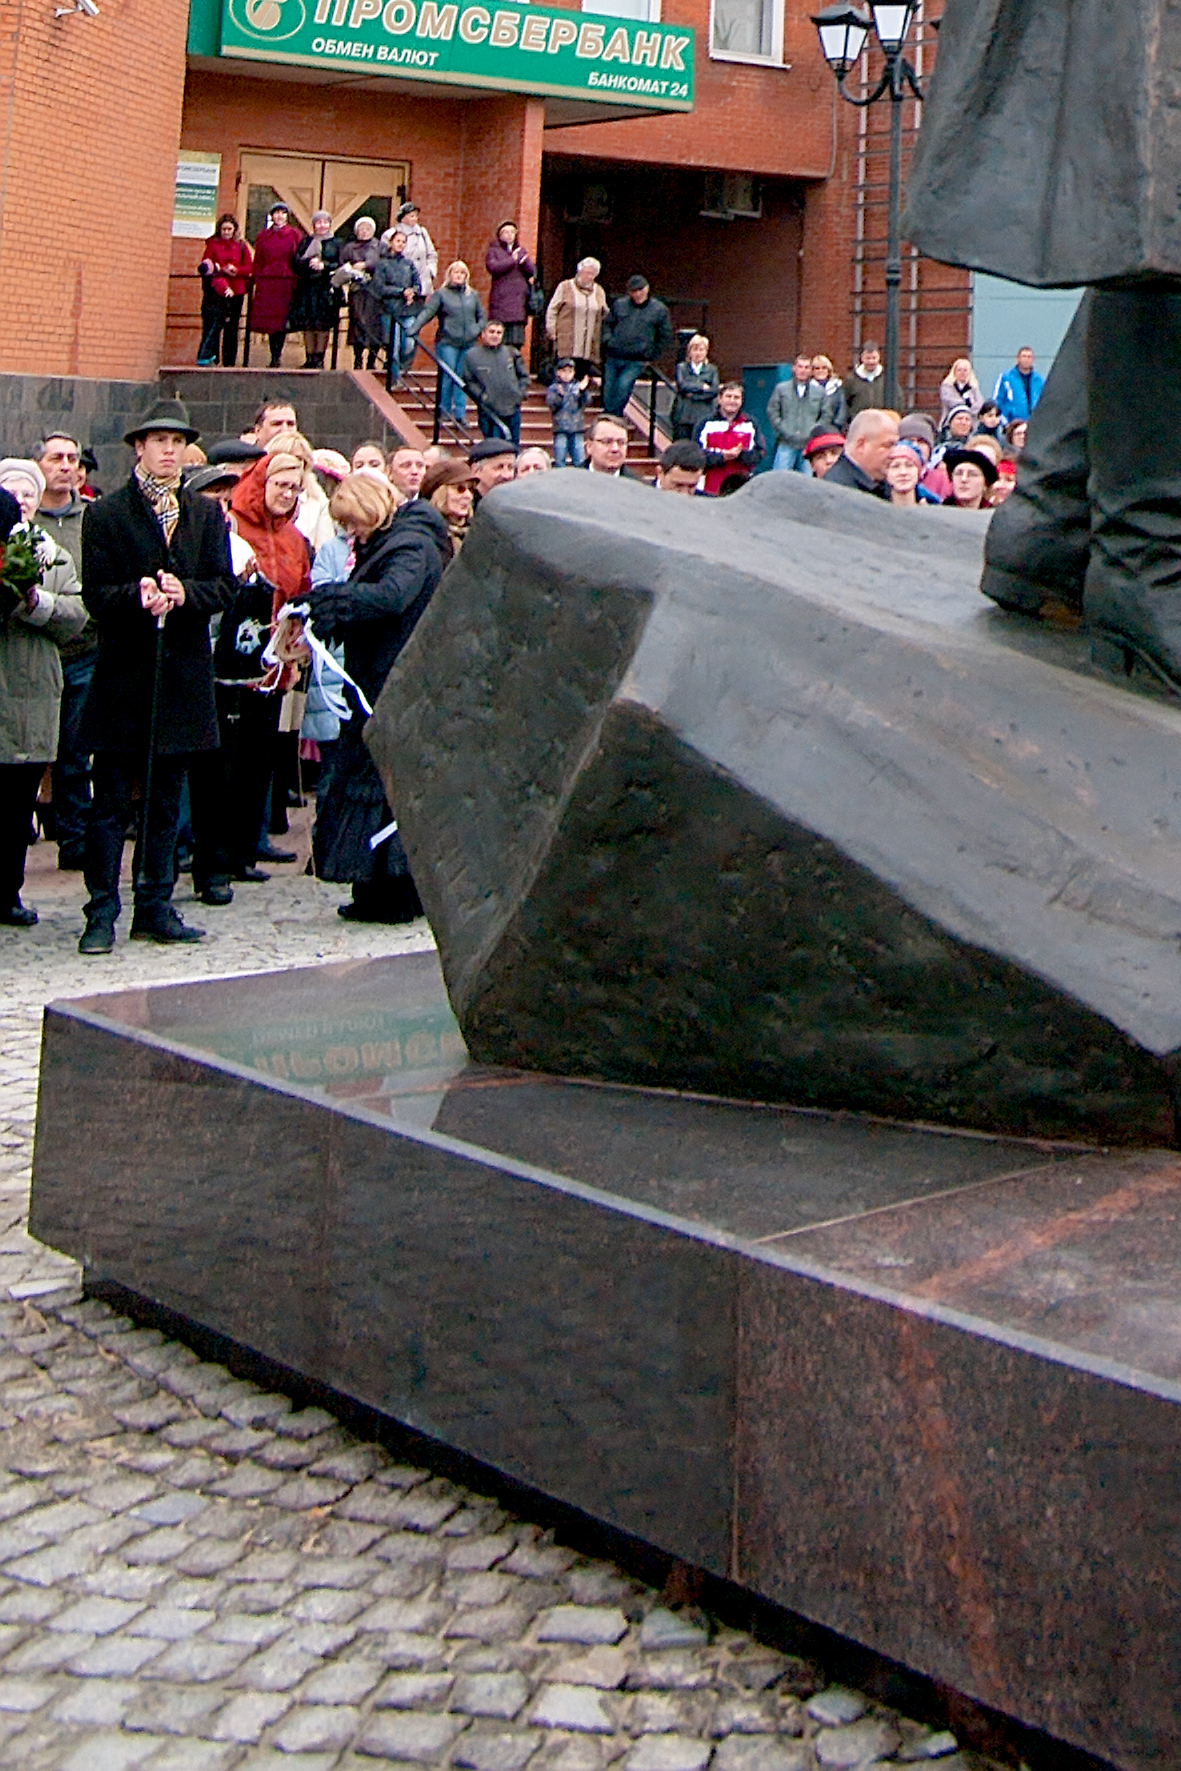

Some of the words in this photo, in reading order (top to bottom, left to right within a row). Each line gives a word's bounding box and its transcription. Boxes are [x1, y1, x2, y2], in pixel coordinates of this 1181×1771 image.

[311, 37, 374, 59] ОБМЕН
[376, 44, 439, 67] ВАЛЮТ
[587, 71, 669, 95] БАНКОМАТ
[669, 81, 689, 98] 24
